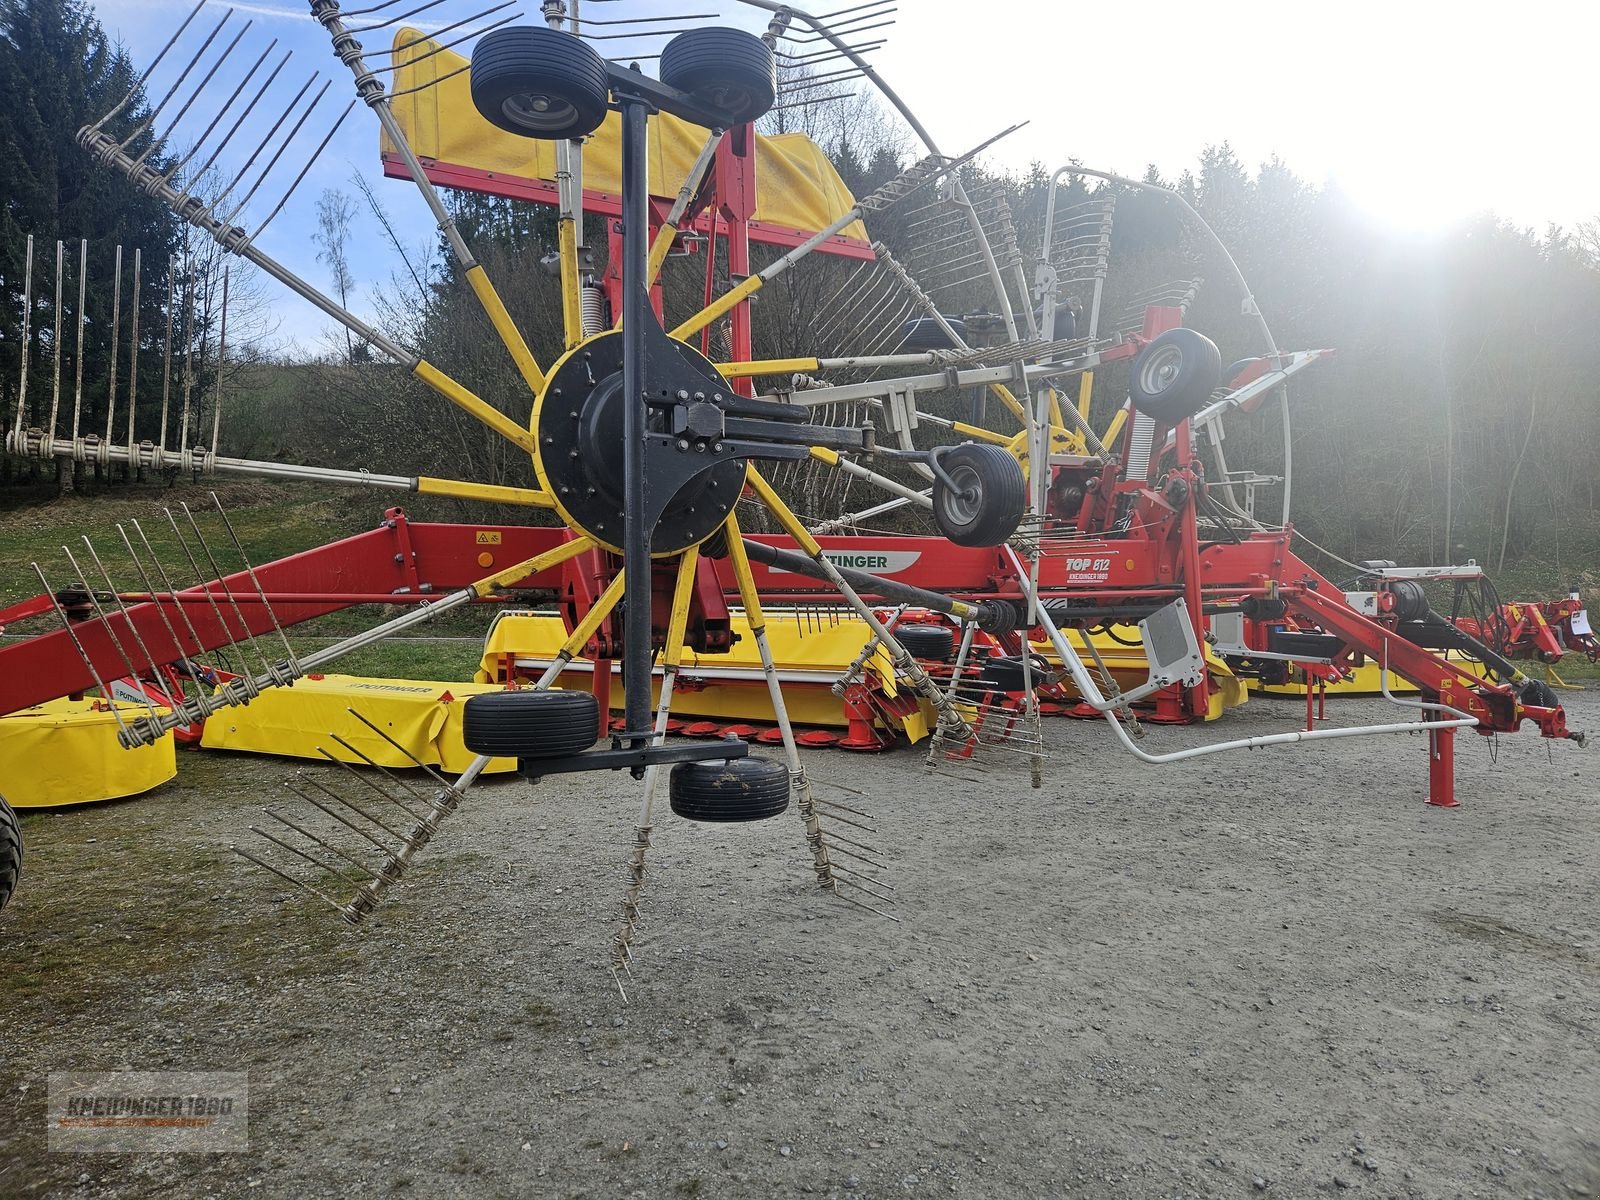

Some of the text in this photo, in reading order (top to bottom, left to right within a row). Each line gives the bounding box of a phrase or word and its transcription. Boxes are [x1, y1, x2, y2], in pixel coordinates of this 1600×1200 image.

[825, 555, 888, 568] TINGER
[1066, 558, 1110, 571] TOP 812
